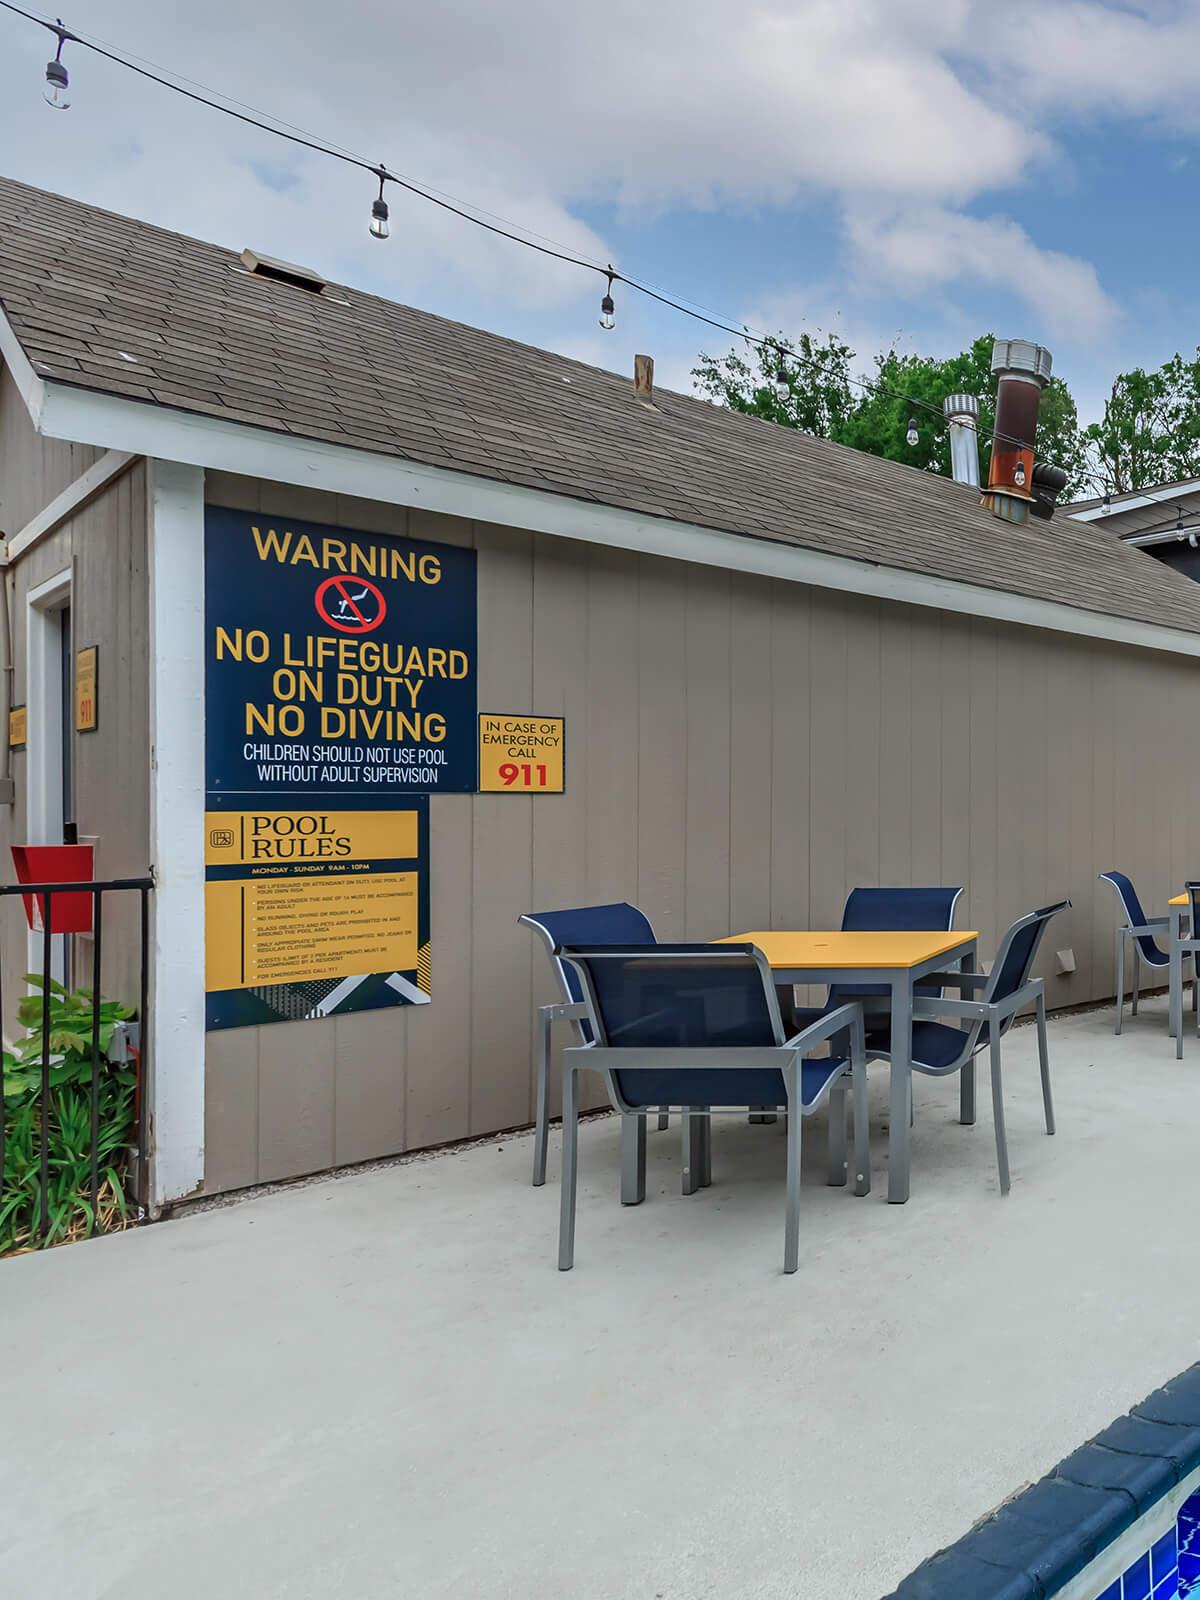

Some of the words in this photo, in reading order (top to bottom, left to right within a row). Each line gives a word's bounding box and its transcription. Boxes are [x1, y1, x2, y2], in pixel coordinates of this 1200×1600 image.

[252, 527, 441, 584] WARNING
[216, 627, 269, 663] NO
[284, 634, 468, 679] LIFEGUARD
[273, 668, 322, 702] ON
[338, 673, 423, 708] DUTY
[246, 703, 304, 736] NO
[321, 707, 446, 742] DIVING
[487, 721, 500, 731] IN
[504, 722, 536, 733] CASE
[540, 724, 556, 734] OF
[483, 734, 559, 746] EMERGENCY
[244, 744, 309, 761] CHILDREN
[313, 746, 363, 763] SHOULD
[366, 748, 391, 763] NOT
[393, 748, 415, 764] USE
[418, 749, 447, 764] POOL
[508, 748, 536, 758] CALL
[257, 764, 318, 782] WITHOUT
[321, 766, 360, 782] ADULT
[363, 767, 437, 783] SUPERVISION
[499, 764, 546, 786] 911
[252, 816, 335, 835] POOL
[252, 838, 352, 858] RULES
